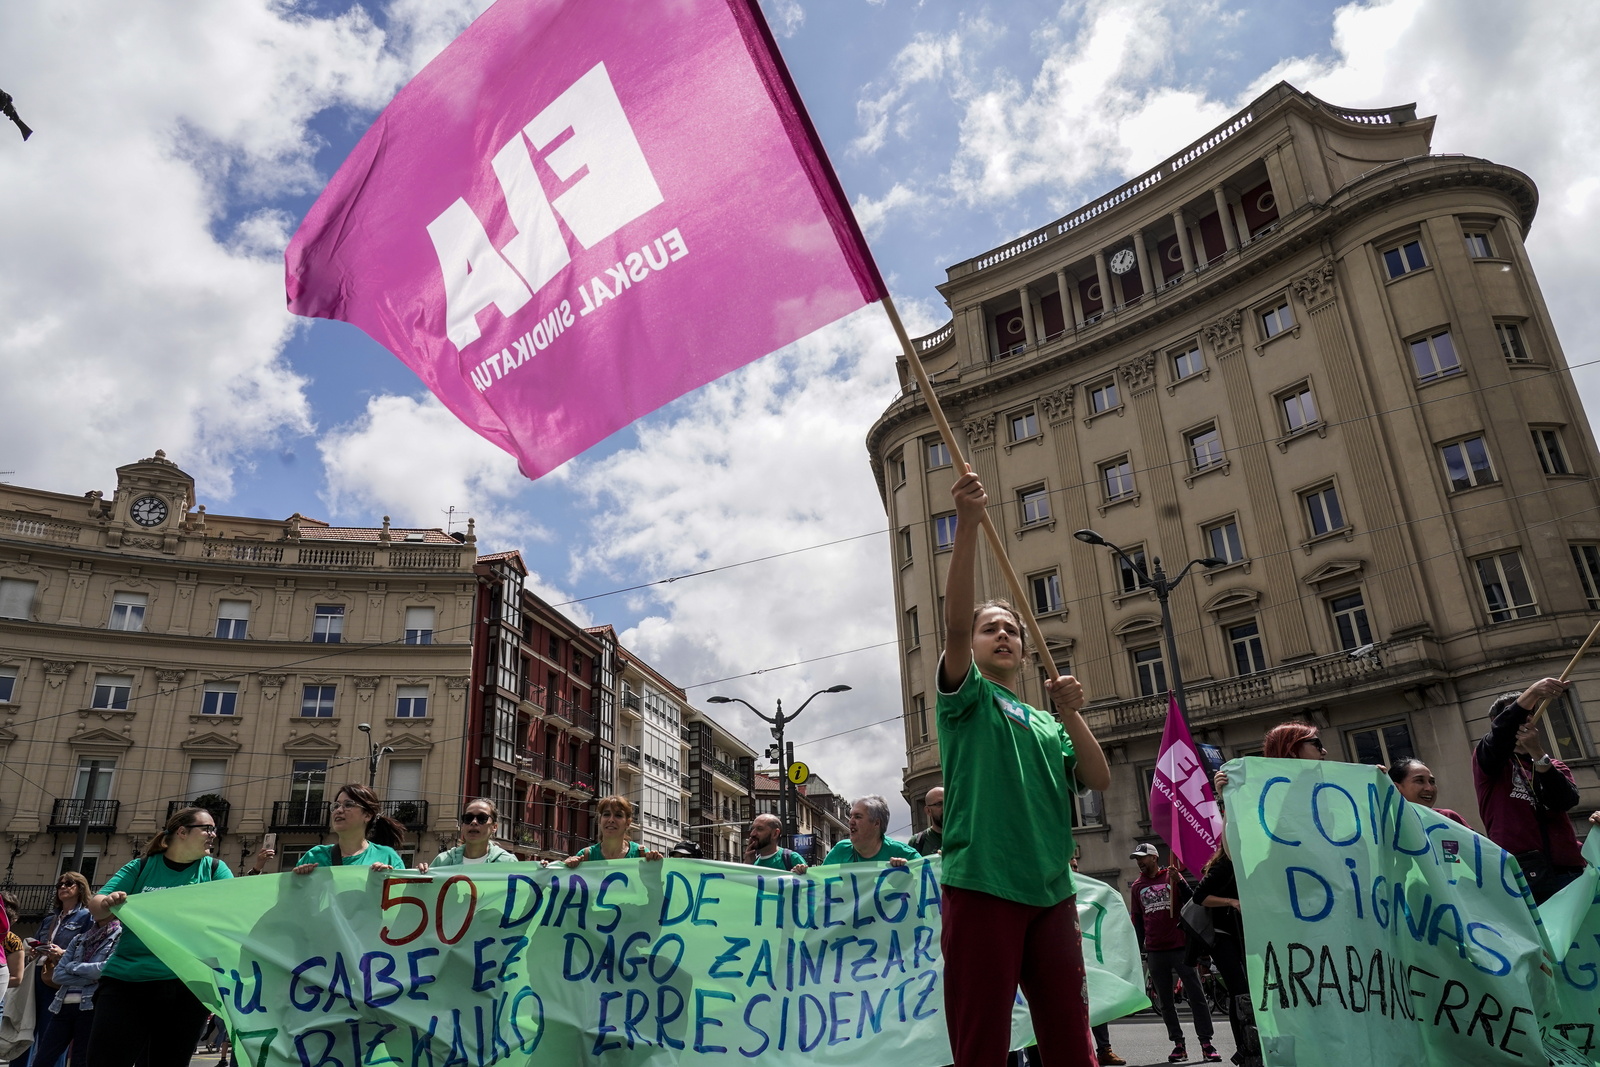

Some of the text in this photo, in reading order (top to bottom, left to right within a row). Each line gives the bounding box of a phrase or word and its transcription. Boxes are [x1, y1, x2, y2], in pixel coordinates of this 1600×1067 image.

[1153, 776, 1218, 852] USKAL SINDIKATUA
[1157, 739, 1223, 840] ELA
[379, 858, 941, 946] 50 DIAS DE HUELGA
[289, 947, 439, 1012] GABE
[471, 935, 529, 993] EZ
[563, 931, 685, 984] DAGO
[708, 925, 936, 991] ZAINTZAR
[592, 969, 938, 1058] ERRESIDENTZ
